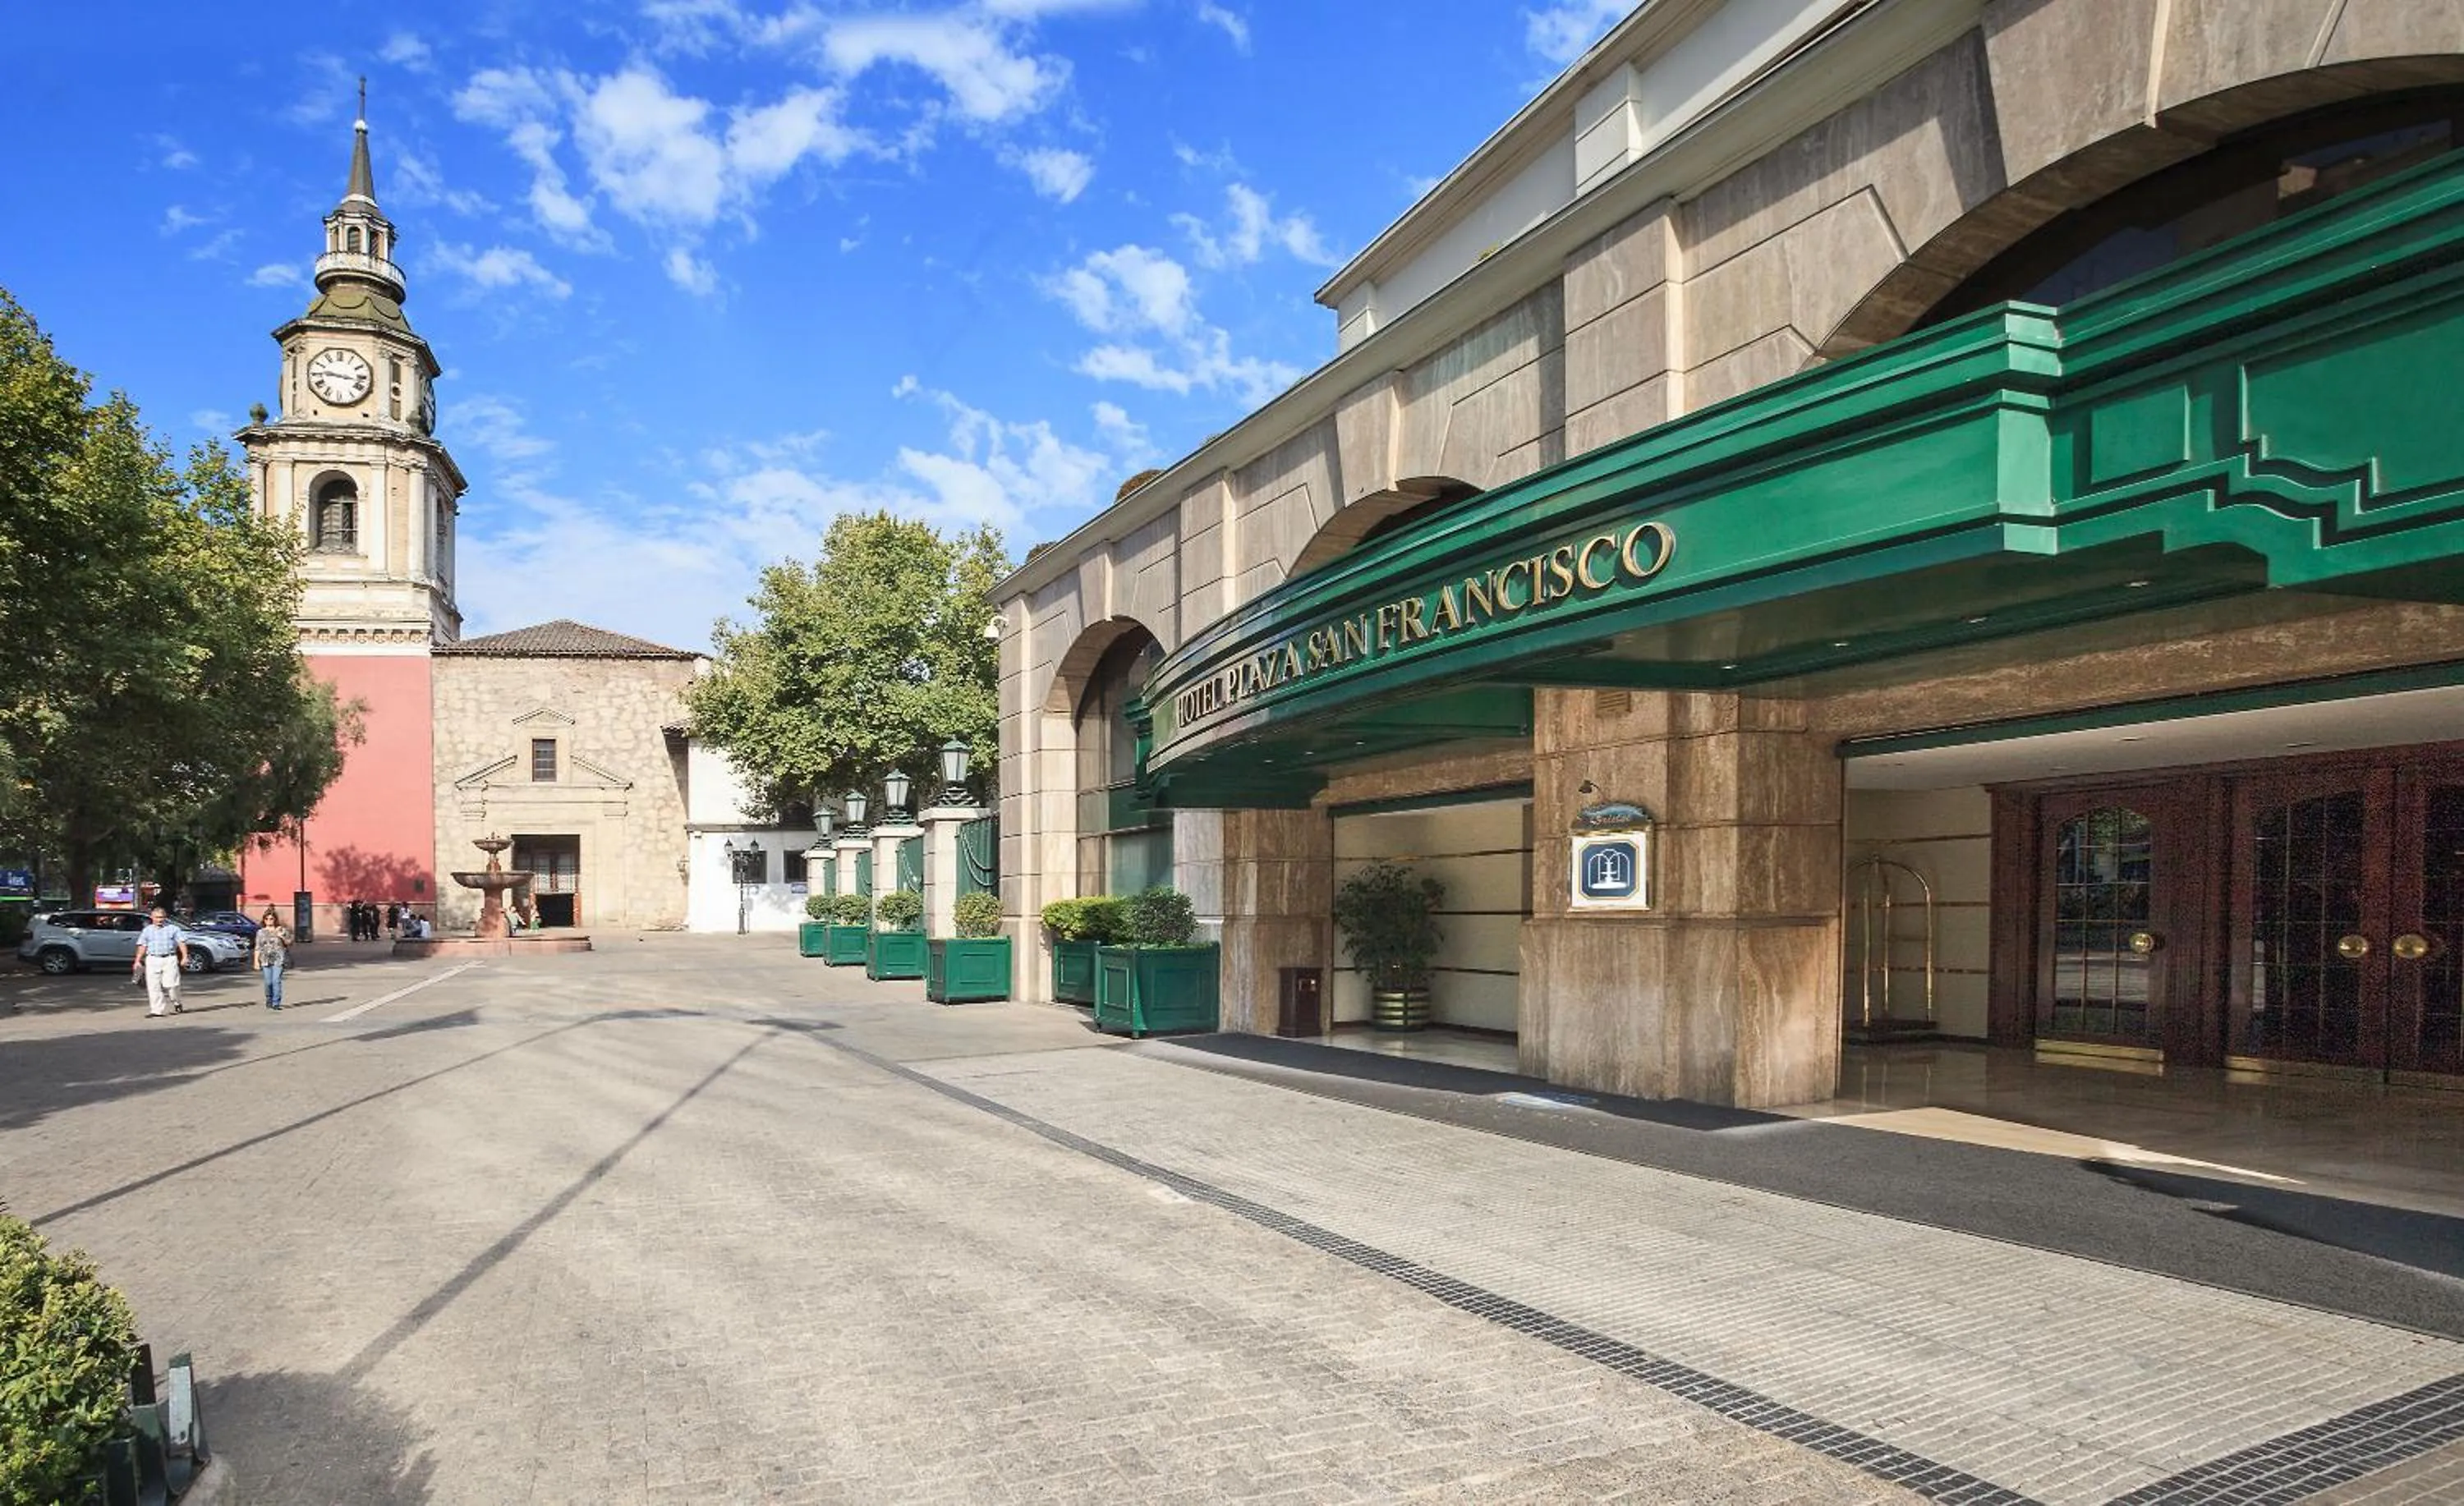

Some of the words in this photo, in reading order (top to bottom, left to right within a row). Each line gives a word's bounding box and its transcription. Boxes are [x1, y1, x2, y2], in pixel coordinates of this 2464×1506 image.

[1178, 678, 1226, 728] HOTEL
[1227, 641, 1303, 705] PLAZA
[1307, 613, 1369, 672] SAN
[1377, 521, 1676, 649] FRANCISCO
